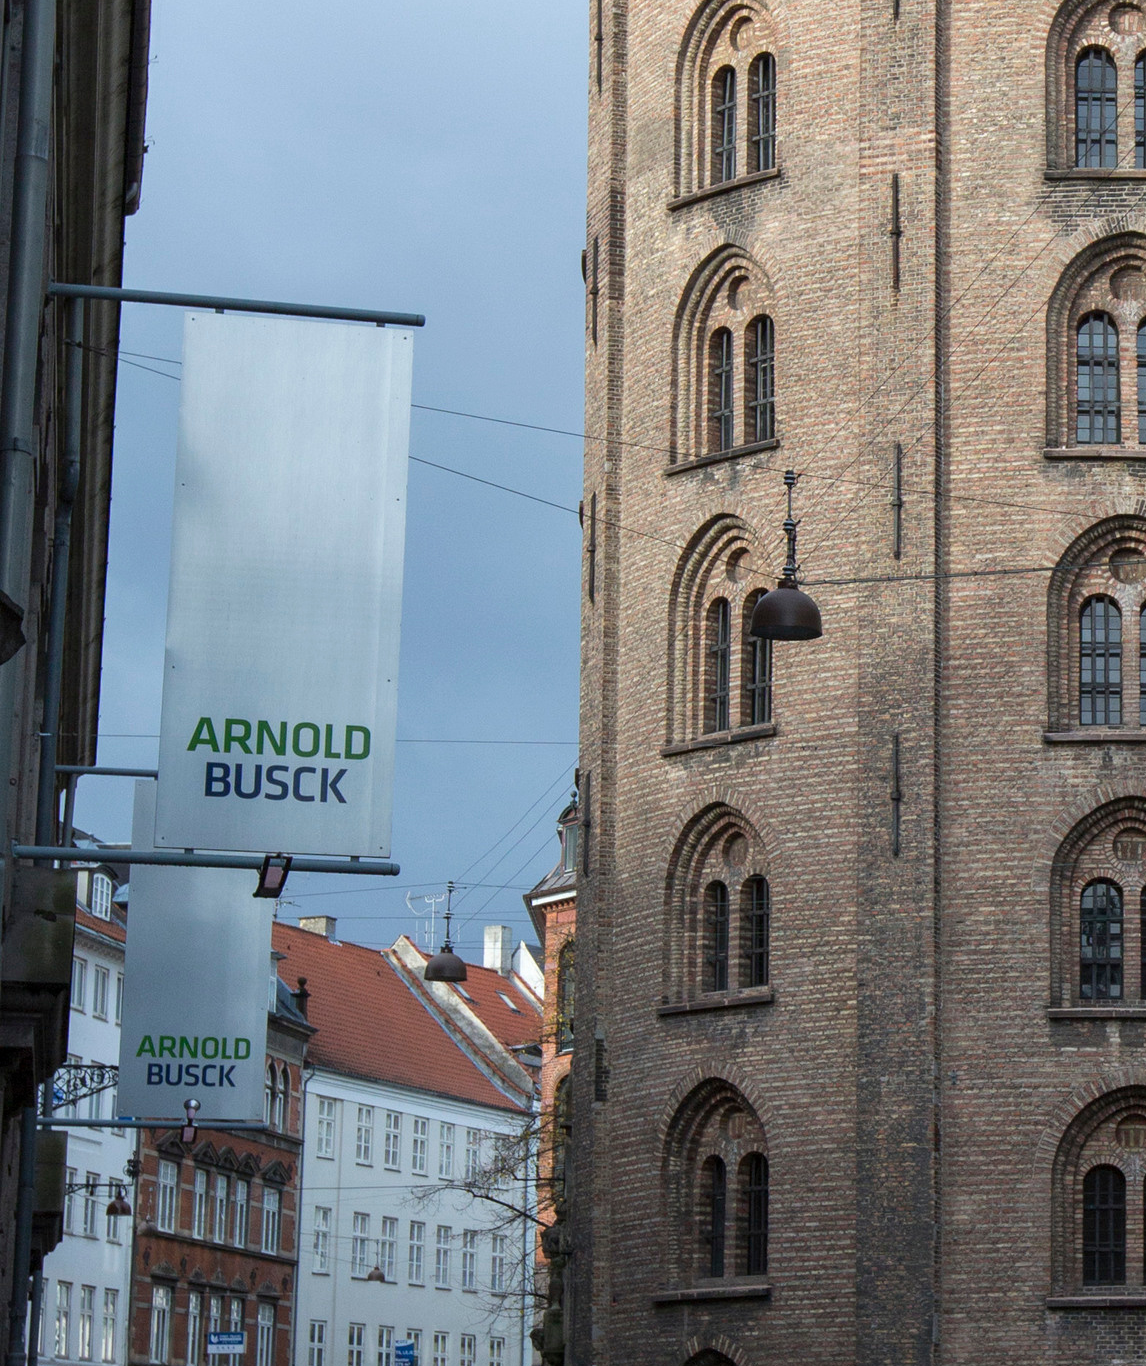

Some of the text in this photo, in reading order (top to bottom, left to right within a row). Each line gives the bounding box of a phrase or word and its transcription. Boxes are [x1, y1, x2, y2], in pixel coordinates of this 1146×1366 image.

[187, 717, 371, 761] ARNOLD
[204, 761, 348, 804] BUSCK
[136, 1035, 251, 1061] ARNOLD
[146, 1063, 236, 1088] BUSCK
